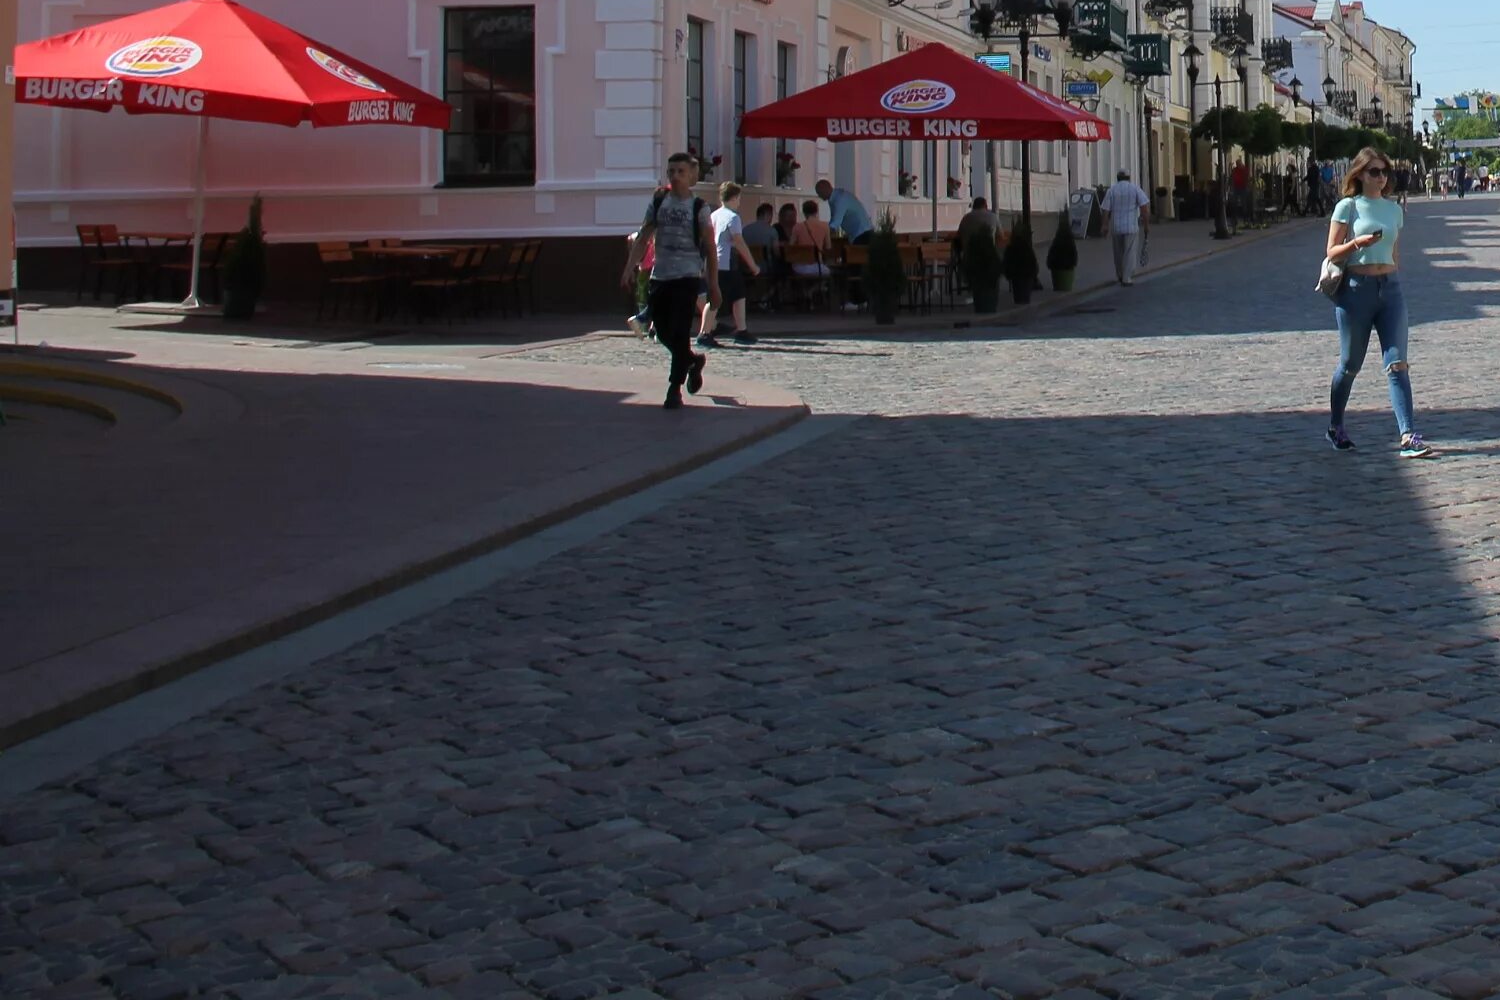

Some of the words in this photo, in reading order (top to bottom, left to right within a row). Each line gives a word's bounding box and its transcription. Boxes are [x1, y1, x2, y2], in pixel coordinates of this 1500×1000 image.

[25, 78, 124, 101] BURGER
[138, 83, 204, 112] KING
[890, 92, 947, 107] KING
[891, 87, 946, 99] BURGER
[348, 100, 390, 122] BURGER
[827, 118, 911, 136] BURGER
[924, 119, 978, 137] KING
